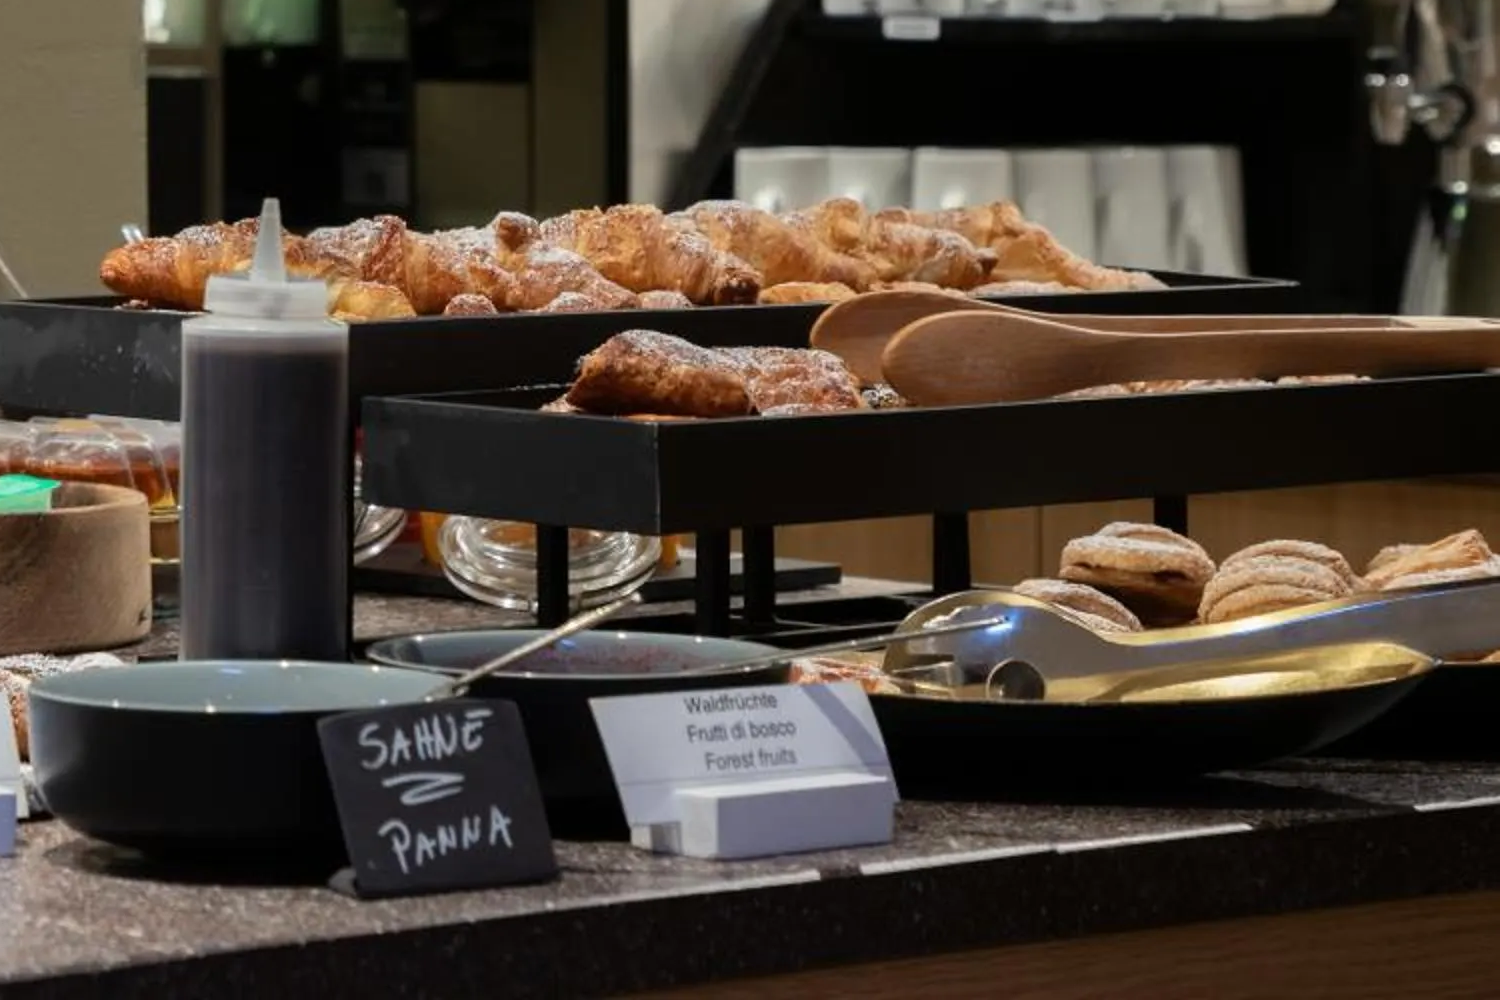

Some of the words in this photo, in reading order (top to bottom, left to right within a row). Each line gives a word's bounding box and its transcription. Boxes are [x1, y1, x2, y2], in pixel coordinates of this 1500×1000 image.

[683, 692, 778, 714] Waldfrüchte
[358, 708, 493, 770] SAHNE
[686, 723, 729, 744] Frutti
[730, 721, 746, 740] di
[748, 720, 797, 739] bosco
[705, 750, 755, 771] Forest
[758, 748, 798, 768] fruits
[377, 804, 513, 875] PANNA
